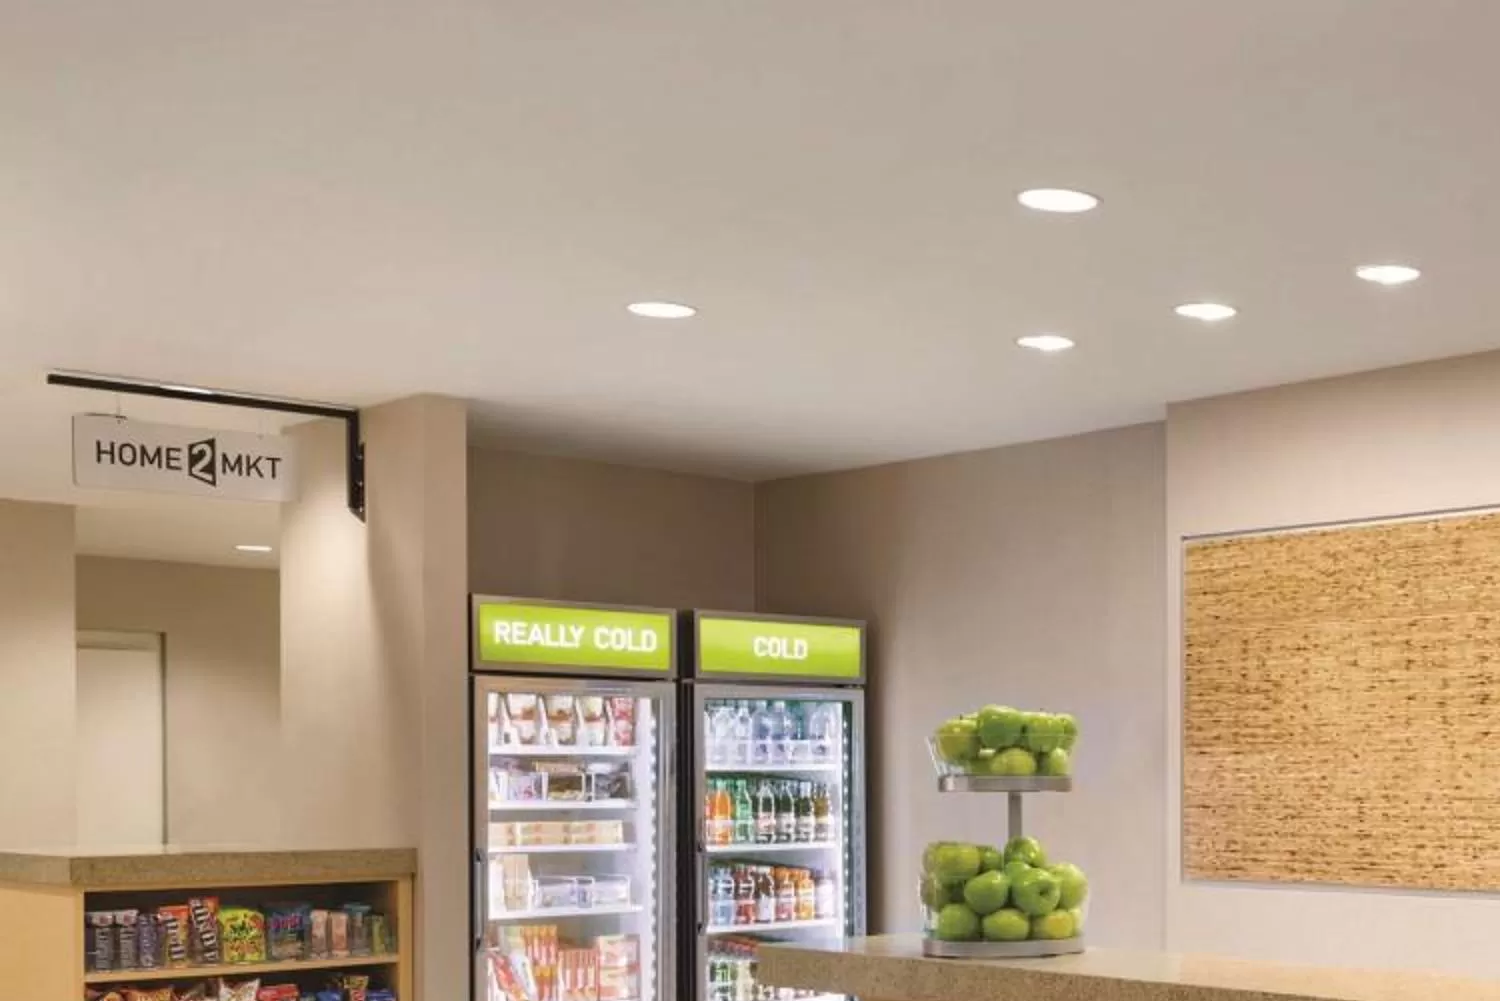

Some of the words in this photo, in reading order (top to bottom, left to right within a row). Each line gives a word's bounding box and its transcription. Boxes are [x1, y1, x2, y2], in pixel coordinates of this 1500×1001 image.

[493, 620, 585, 649] REALLY
[594, 628, 658, 653] COLD
[753, 636, 809, 661] COLD
